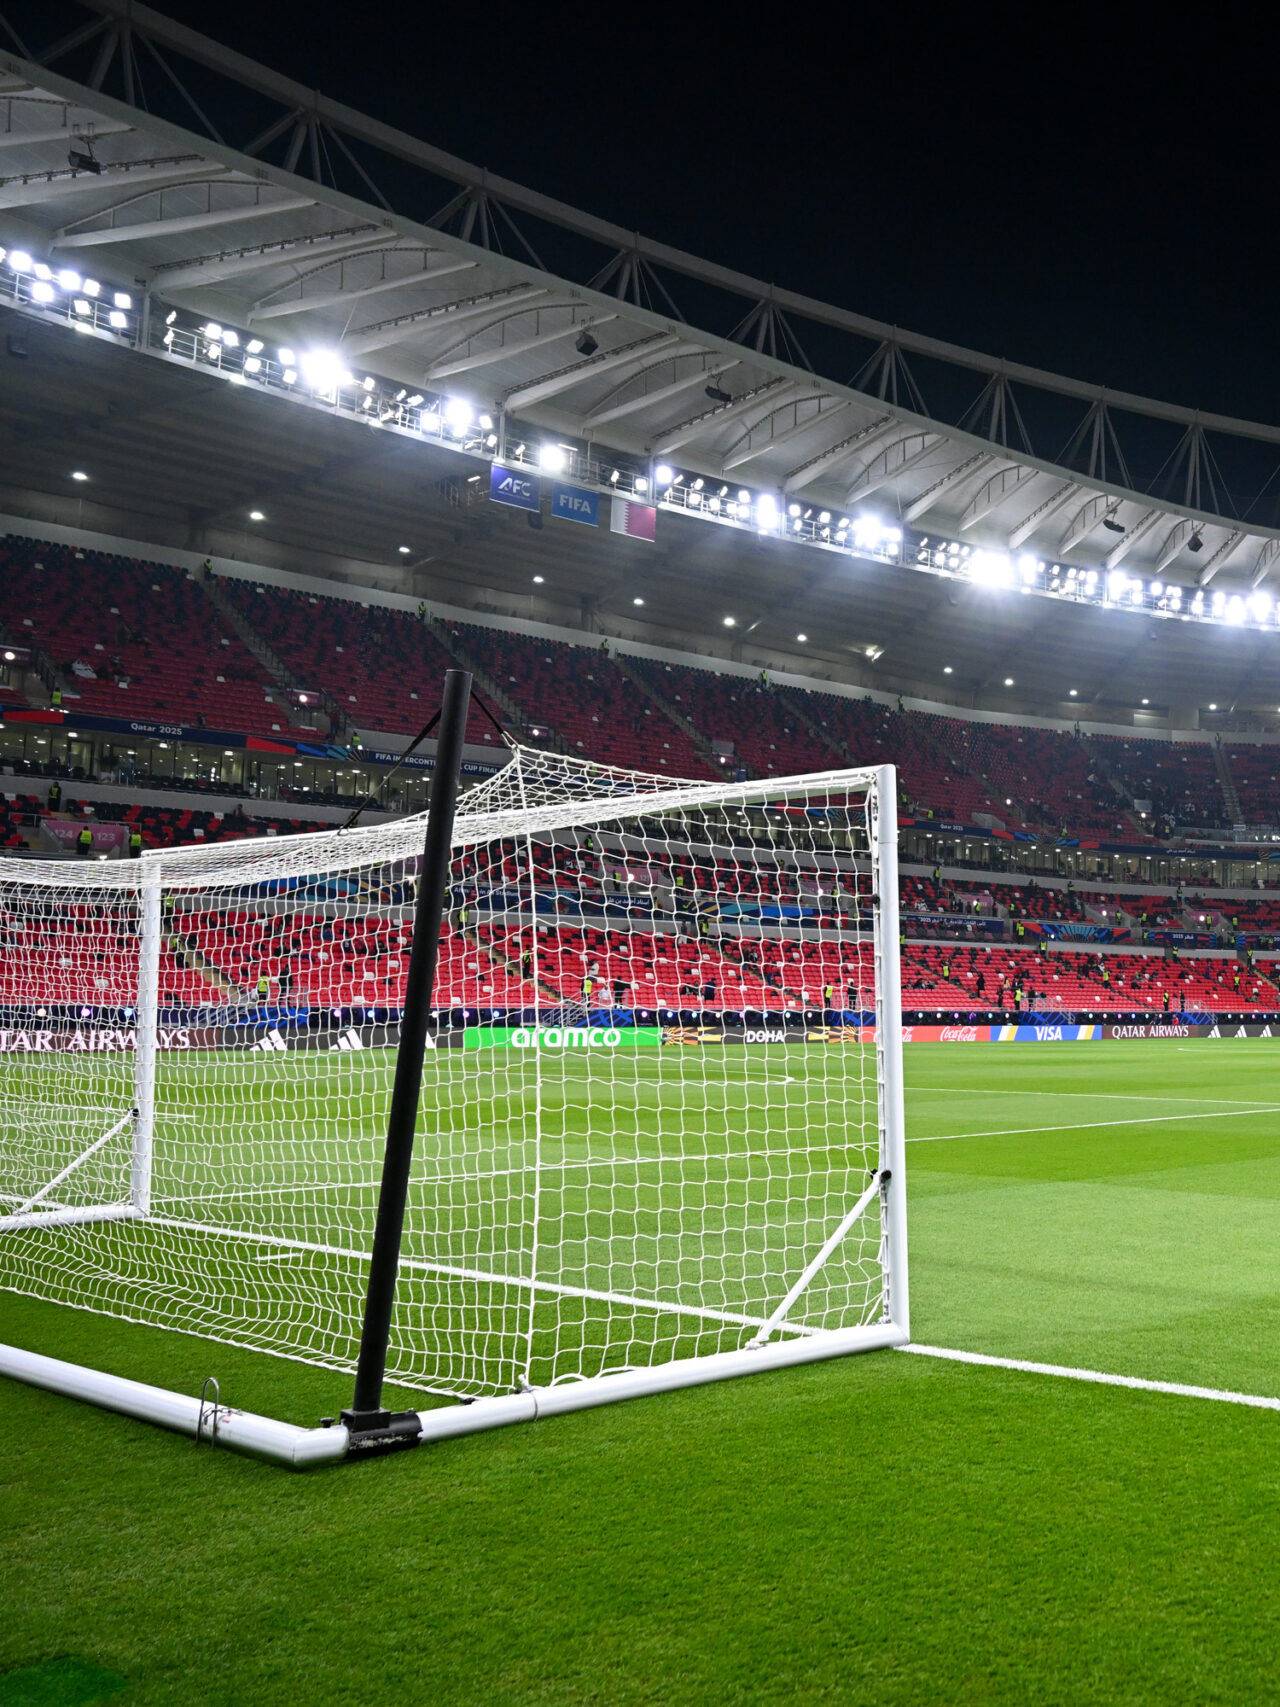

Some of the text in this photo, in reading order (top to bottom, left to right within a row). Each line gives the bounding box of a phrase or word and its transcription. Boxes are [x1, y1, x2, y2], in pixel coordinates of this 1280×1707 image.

[498, 477, 531, 496] AFC
[560, 494, 591, 513] FIFA
[130, 723, 182, 735] Qatar 2025
[375, 753, 391, 761] FIFA
[464, 764, 478, 772] CUP
[511, 1028, 621, 1048] aramco
[746, 1030, 785, 1043] DOHA
[1034, 1026, 1062, 1041] VISA
[1112, 1025, 1189, 1039] QATAR AIRWAYS
